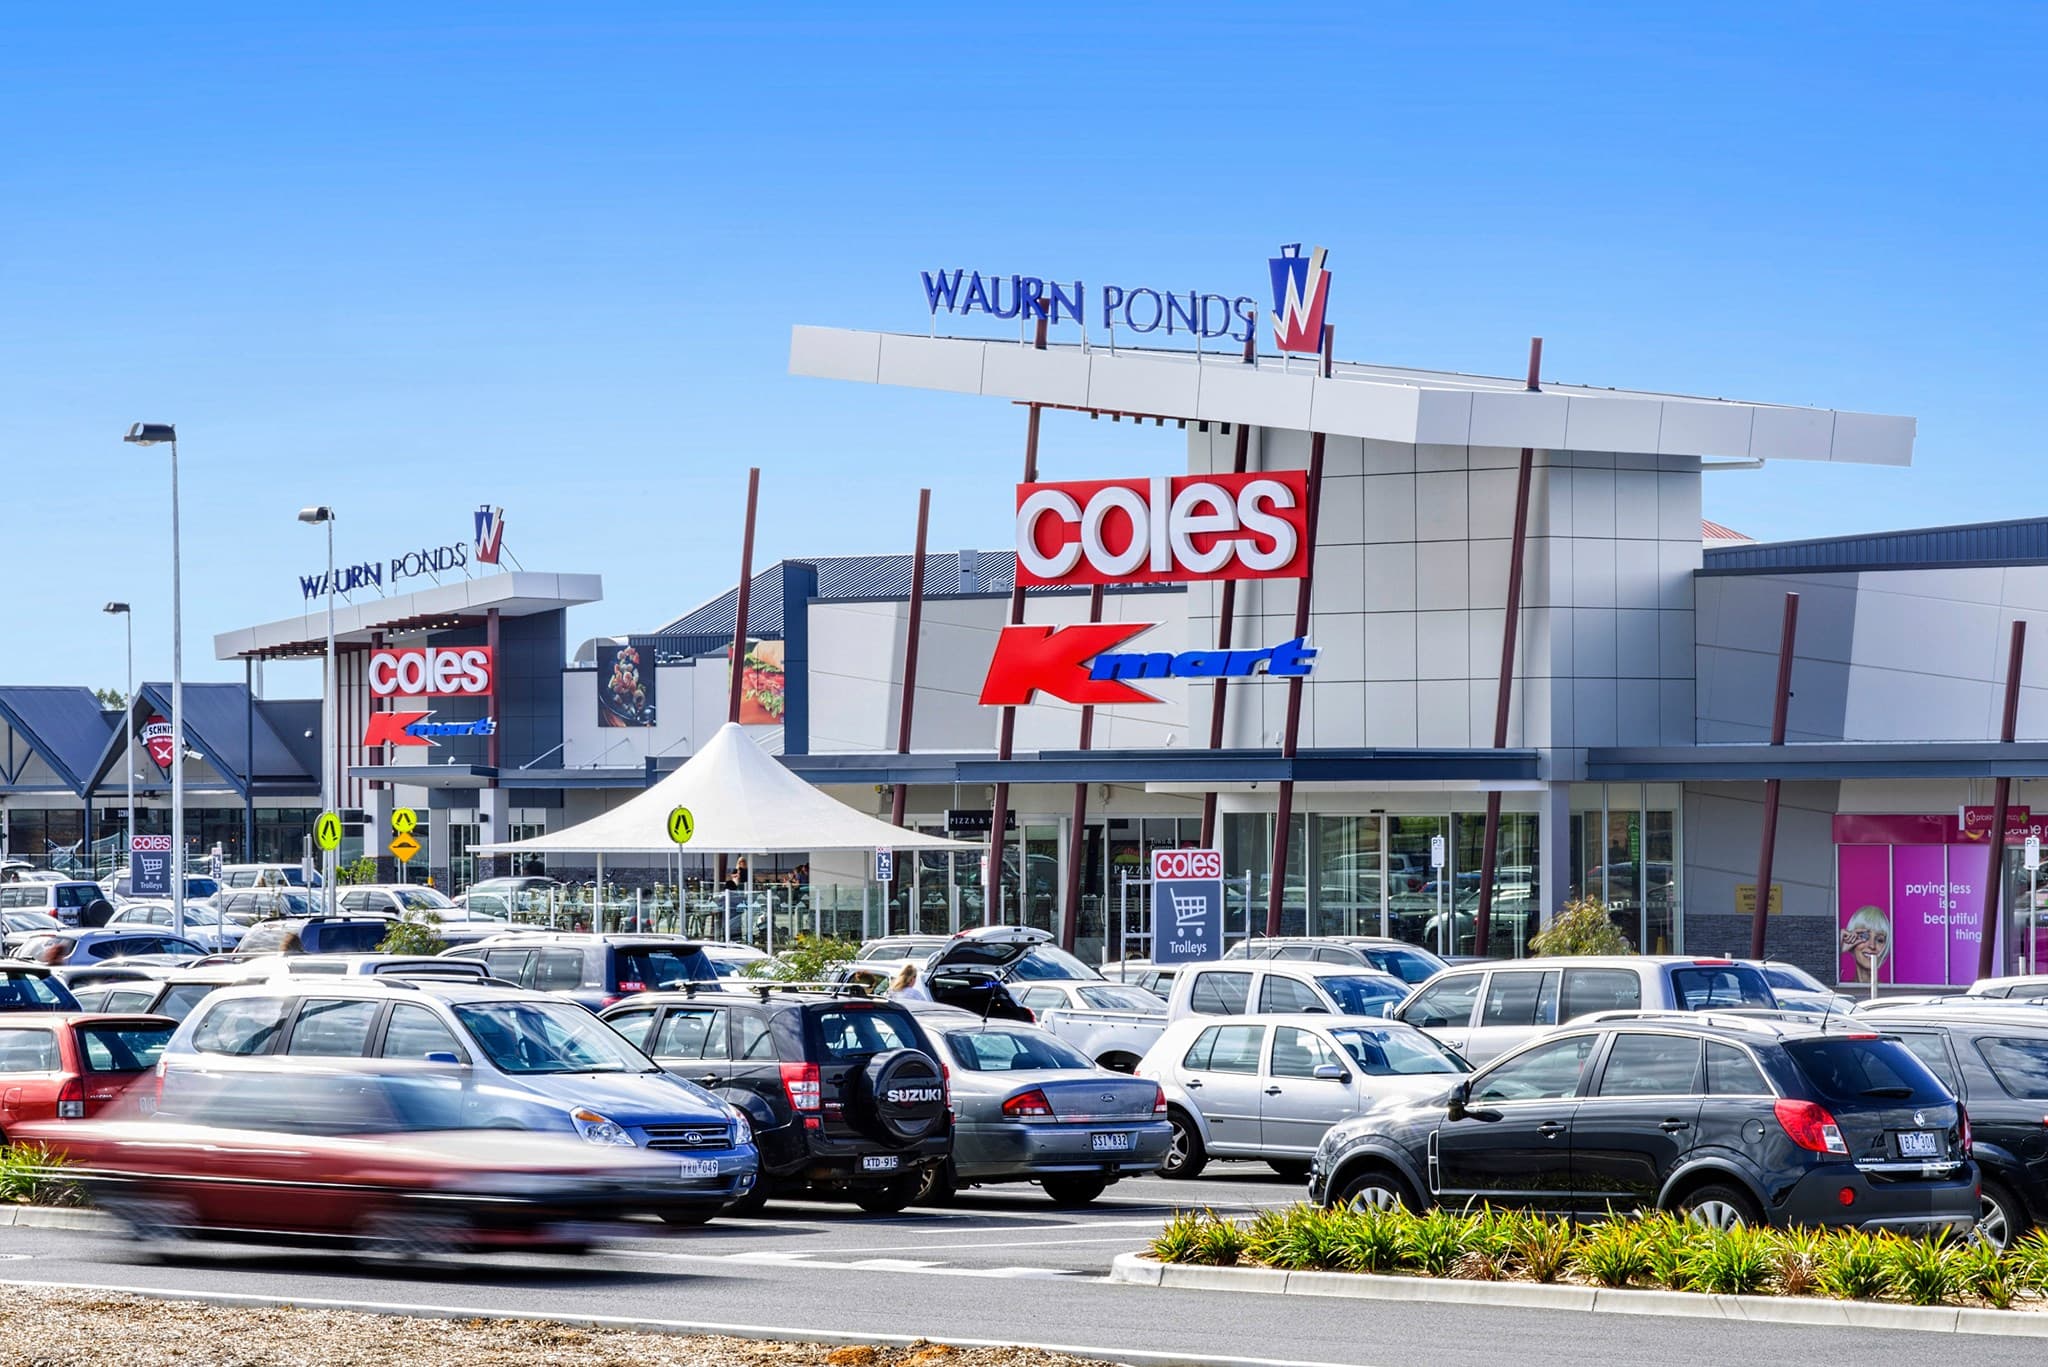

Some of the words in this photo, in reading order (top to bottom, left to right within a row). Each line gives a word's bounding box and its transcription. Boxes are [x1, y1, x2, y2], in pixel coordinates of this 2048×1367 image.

[920, 269, 1084, 325] WAURN
[1103, 285, 1257, 342] PONDS
[1016, 477, 1298, 578] coles
[299, 561, 383, 600] WAURN
[391, 542, 466, 583] PONDS
[369, 647, 488, 694] coles
[978, 620, 1323, 707] Kmart
[363, 710, 496, 747] Kmart
[949, 817, 975, 825] PIZZA
[133, 837, 170, 850] coles
[1157, 852, 1220, 878] coles
[1949, 882, 1972, 894] less
[1169, 941, 1208, 957] Trolleys
[1955, 929, 1982, 943] thing
[887, 1089, 941, 1102] SUZUKI
